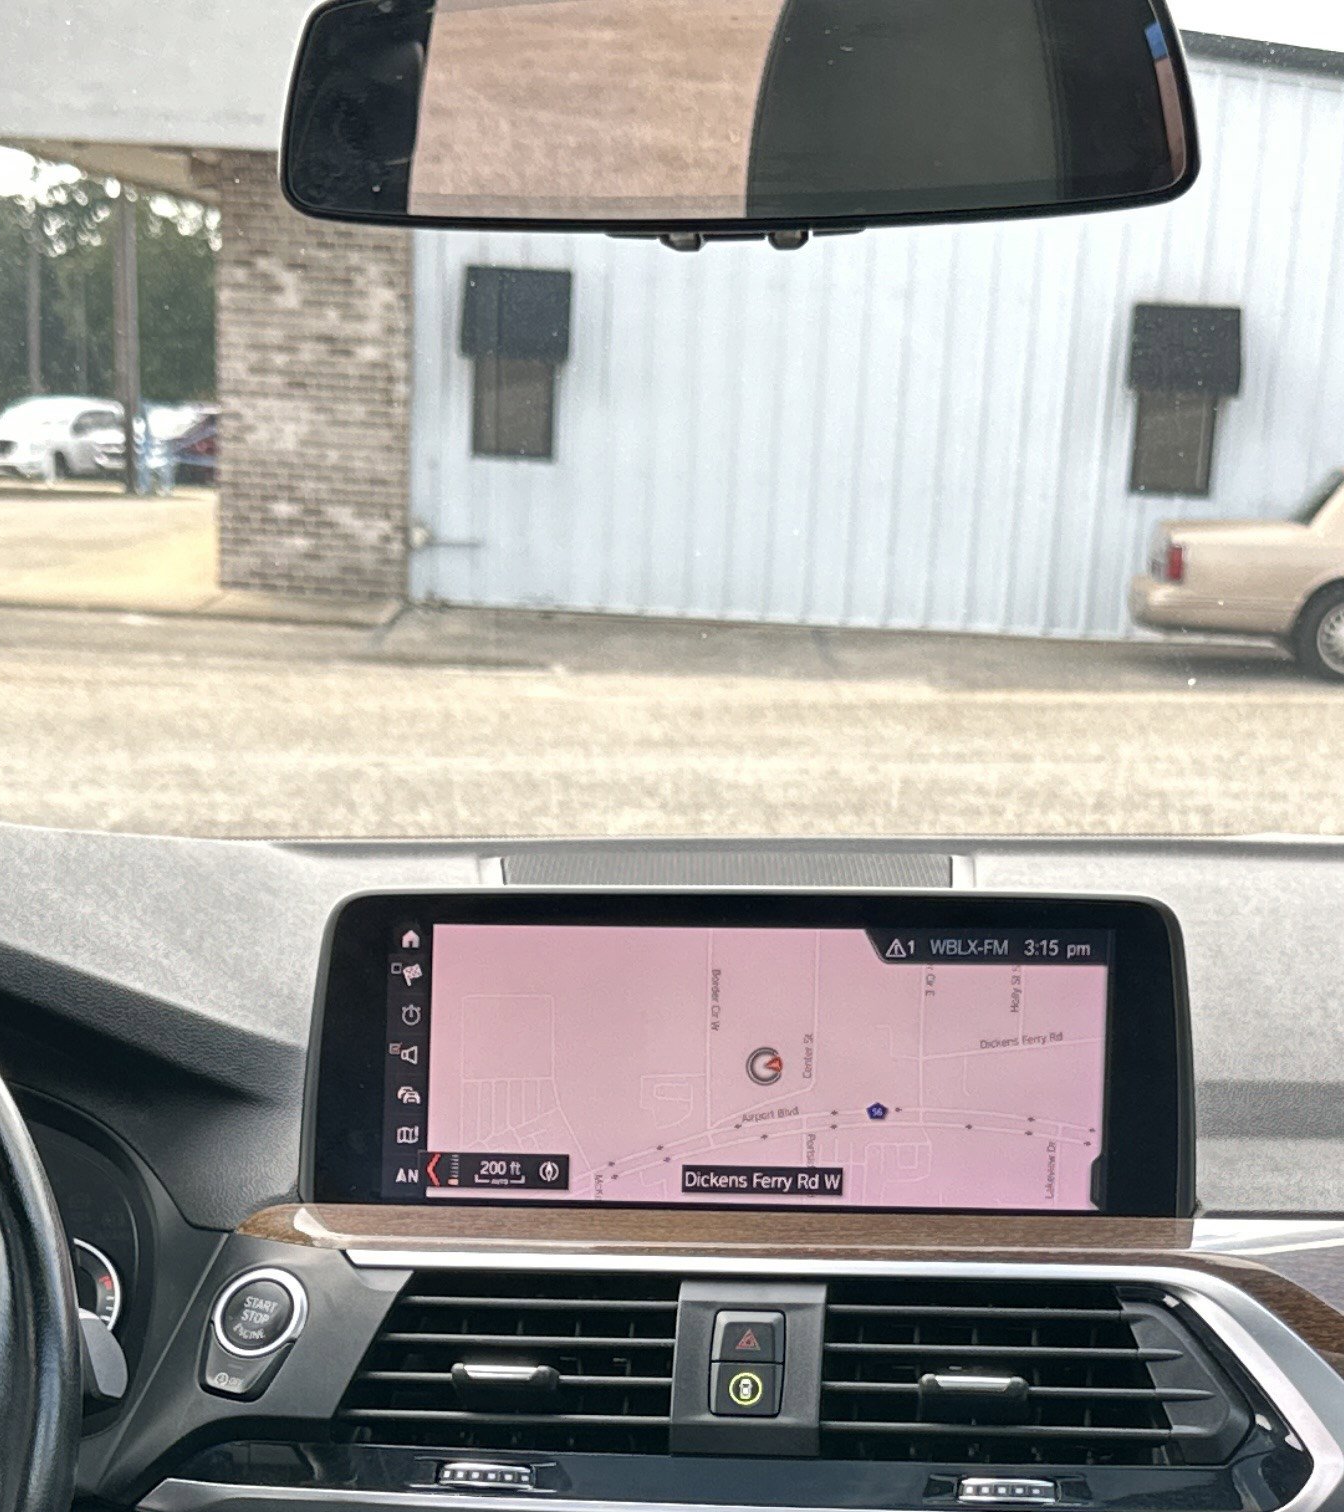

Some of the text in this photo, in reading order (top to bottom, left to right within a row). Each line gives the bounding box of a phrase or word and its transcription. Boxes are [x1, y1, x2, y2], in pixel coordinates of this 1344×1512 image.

[930, 939, 1009, 956] WBLX-FM
[1024, 939, 1059, 957] 3:15
[1067, 943, 1091, 959] pm
[711, 969, 722, 1002] Border
[979, 1031, 1063, 1050] Dickens Ferry Rd
[742, 1106, 800, 1123] Airport Blvd
[395, 1168, 419, 1183] AN
[479, 1160, 522, 1176] 200 ft
[684, 1170, 841, 1193] Dickens Ferry Rd W
[243, 1295, 279, 1313] START
[241, 1308, 271, 1324] STOP
